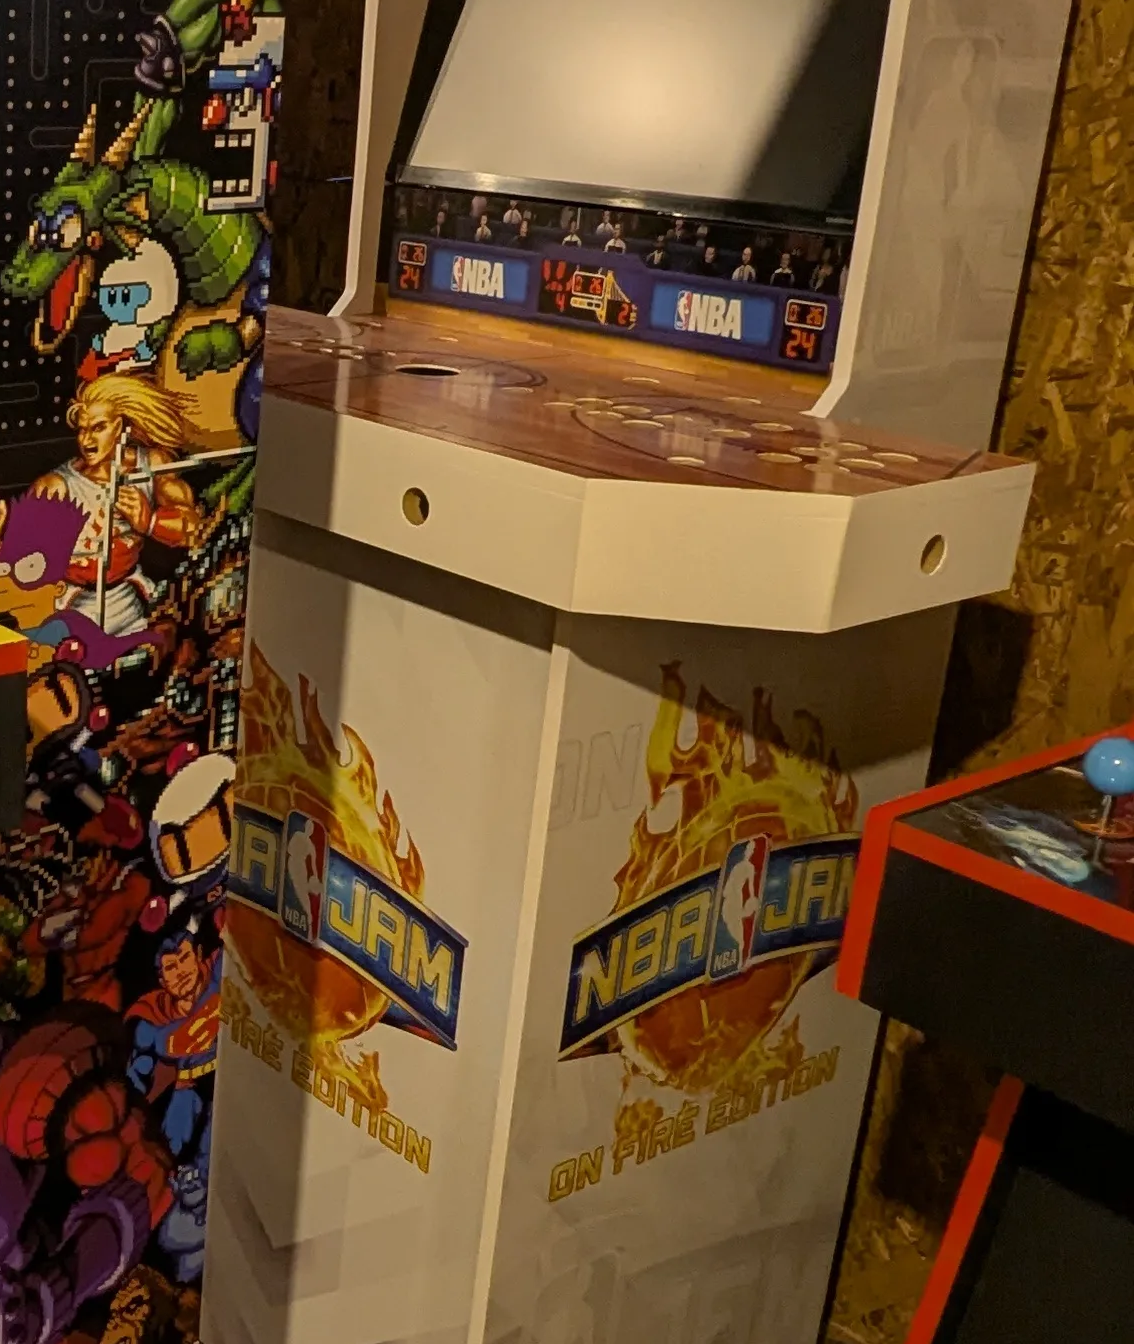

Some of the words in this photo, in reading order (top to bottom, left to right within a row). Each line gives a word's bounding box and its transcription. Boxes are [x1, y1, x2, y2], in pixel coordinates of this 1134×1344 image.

[398, 264, 420, 290] 24
[462, 256, 505, 299] NBA
[688, 292, 743, 341] NBA
[785, 328, 815, 360] 24
[285, 905, 308, 934] NBA
[327, 878, 455, 1015] JAM
[572, 886, 714, 1026] NBA
[715, 948, 737, 971] NBA
[291, 1049, 432, 1174] EDITION
[547, 1144, 605, 1203] ON
[612, 1103, 700, 1176] FIRE
[704, 1045, 841, 1136] EDITION
